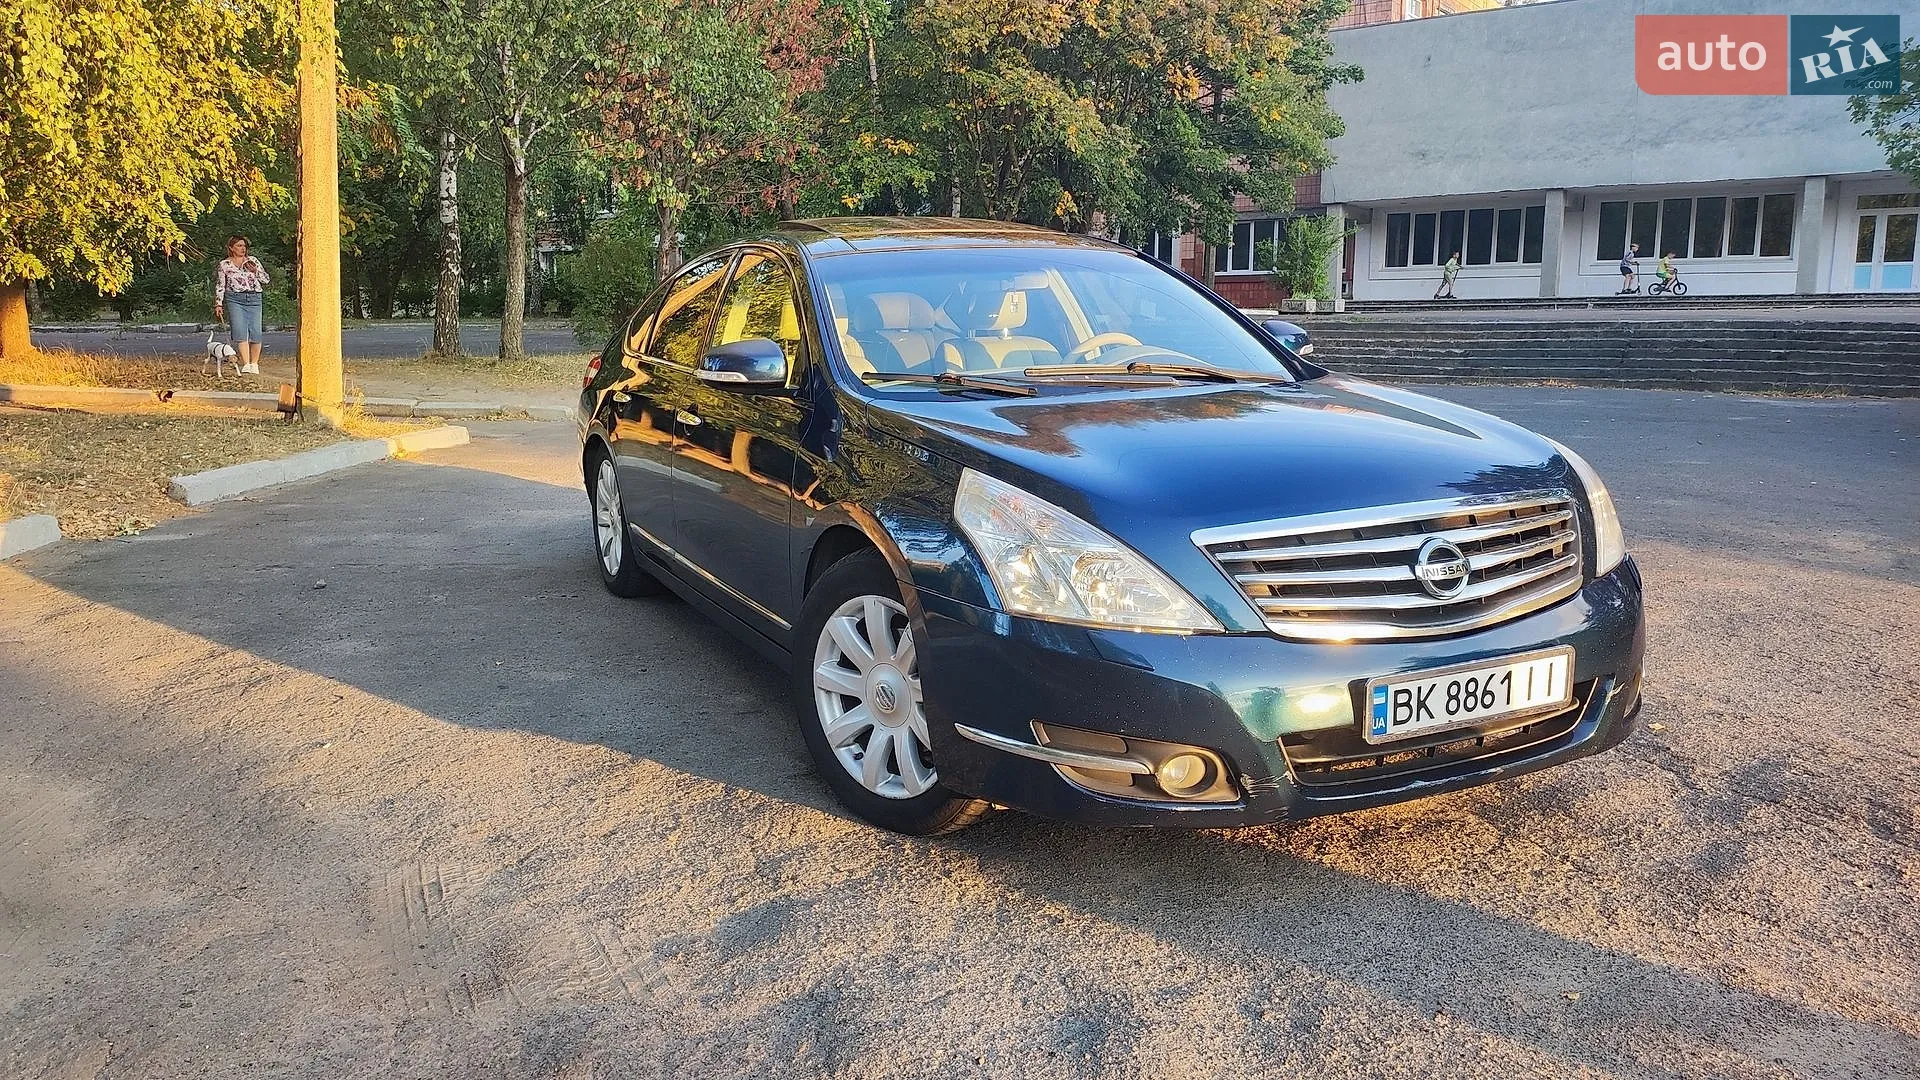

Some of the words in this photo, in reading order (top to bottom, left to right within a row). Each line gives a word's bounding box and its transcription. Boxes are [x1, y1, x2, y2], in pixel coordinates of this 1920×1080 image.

[1424, 563, 1469, 578] NISSAN
[1392, 683, 1437, 726] BK
[1445, 670, 1513, 716] 8861
[1372, 717, 1386, 730] UA
